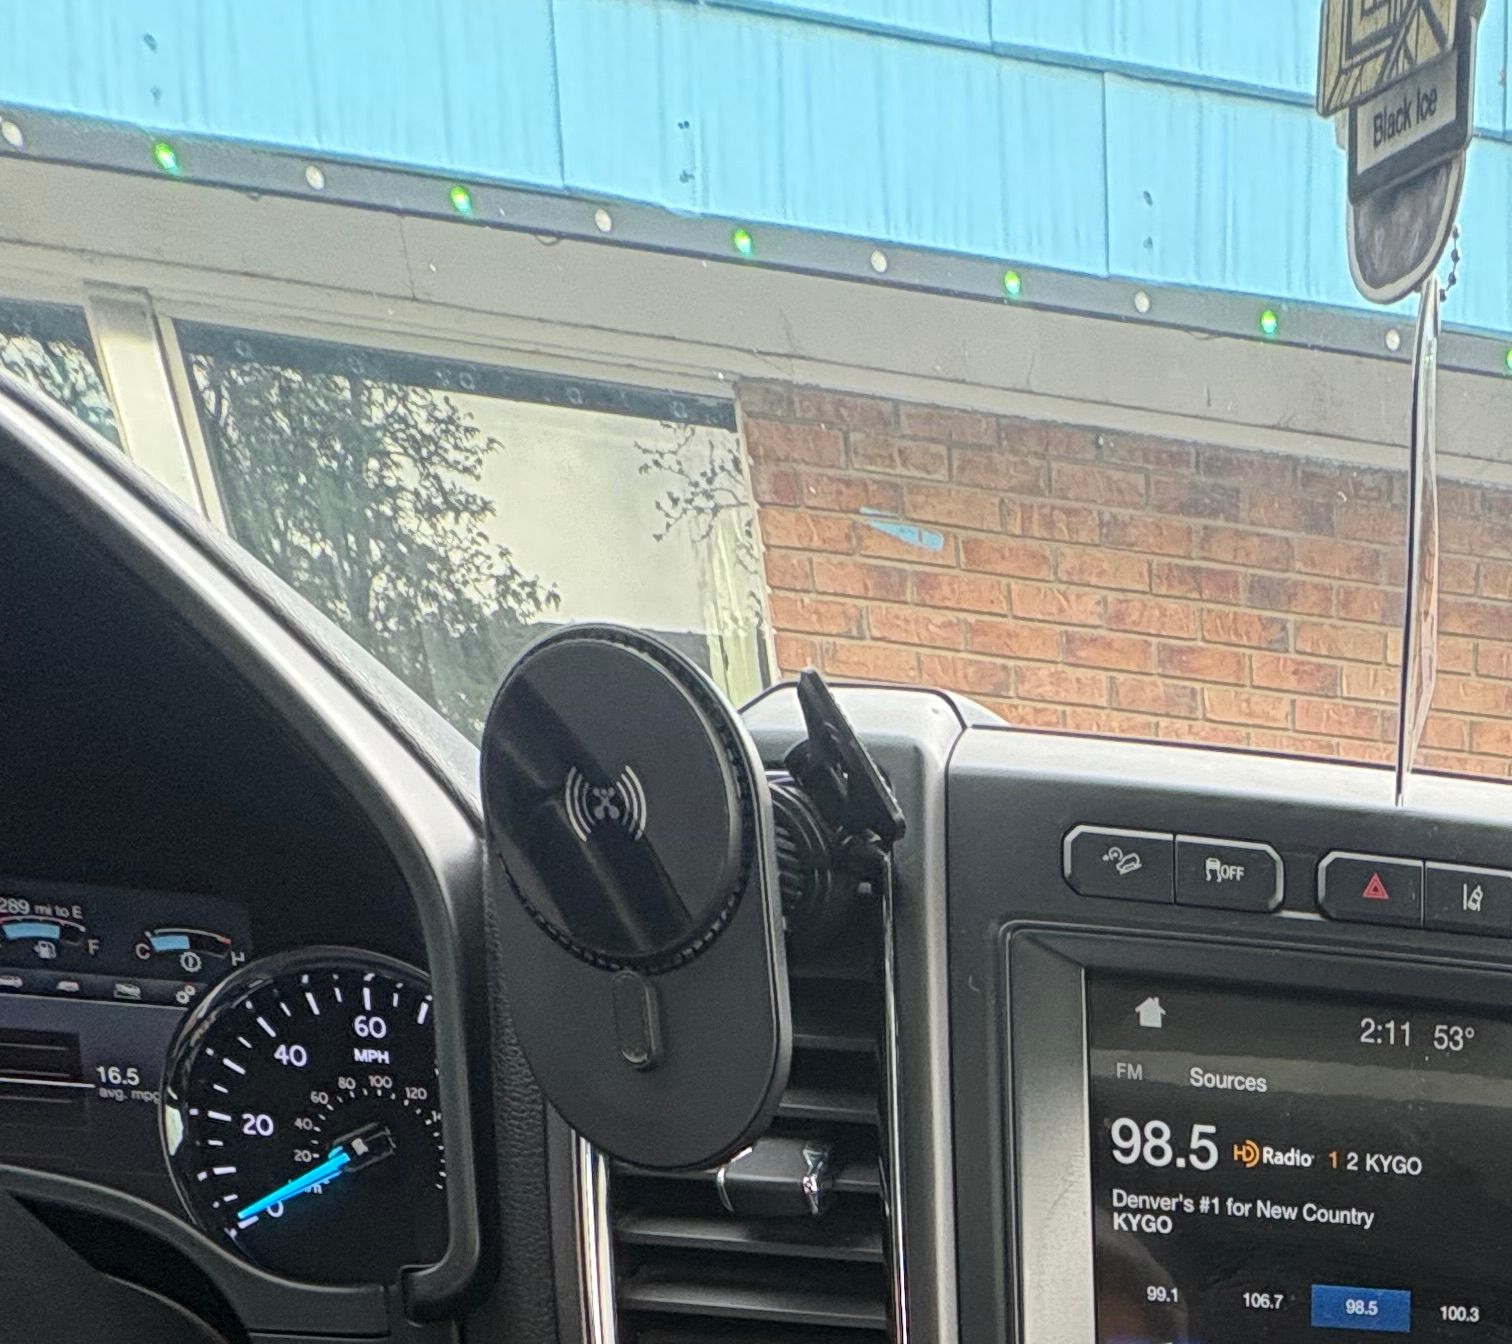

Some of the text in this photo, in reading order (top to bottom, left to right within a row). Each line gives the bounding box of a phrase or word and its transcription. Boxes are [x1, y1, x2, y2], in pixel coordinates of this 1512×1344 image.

[1373, 87, 1438, 147] Black Ice
[1221, 865, 1245, 881] OFF
[34, 904, 51, 915] mi
[55, 905, 70, 917] to
[72, 906, 83, 919] E
[87, 939, 99, 955] F
[135, 943, 151, 959] C
[354, 1015, 387, 1038] 60
[1360, 1017, 1411, 1047] 2:11
[274, 1044, 307, 1067] 40
[354, 1048, 390, 1064] MPH
[96, 1065, 140, 1086] 16.5
[1116, 1062, 1143, 1081] FM
[1189, 1067, 1268, 1092] Sources
[338, 1077, 356, 1090] 80
[368, 1075, 392, 1089] 100
[99, 1090, 128, 1102] avg.
[310, 1091, 329, 1104] 60
[405, 1087, 427, 1100] 120
[242, 1113, 274, 1136] 20
[294, 1117, 313, 1131] 40
[1111, 1117, 1219, 1171] 98.5
[1262, 1146, 1314, 1168] Radio
[1329, 1152, 1338, 1169] 1
[1347, 1152, 1359, 1171] 2
[1365, 1153, 1423, 1176] KYGO
[294, 1149, 312, 1162] 20
[1112, 1188, 1375, 1230] Denver's #1 for New Country
[1113, 1212, 1173, 1234] KYGO
[1147, 1286, 1179, 1303] 99.1
[1243, 1292, 1284, 1310] 106.7
[1345, 1299, 1378, 1316] 98.5
[1440, 1305, 1480, 1323] 100.3
